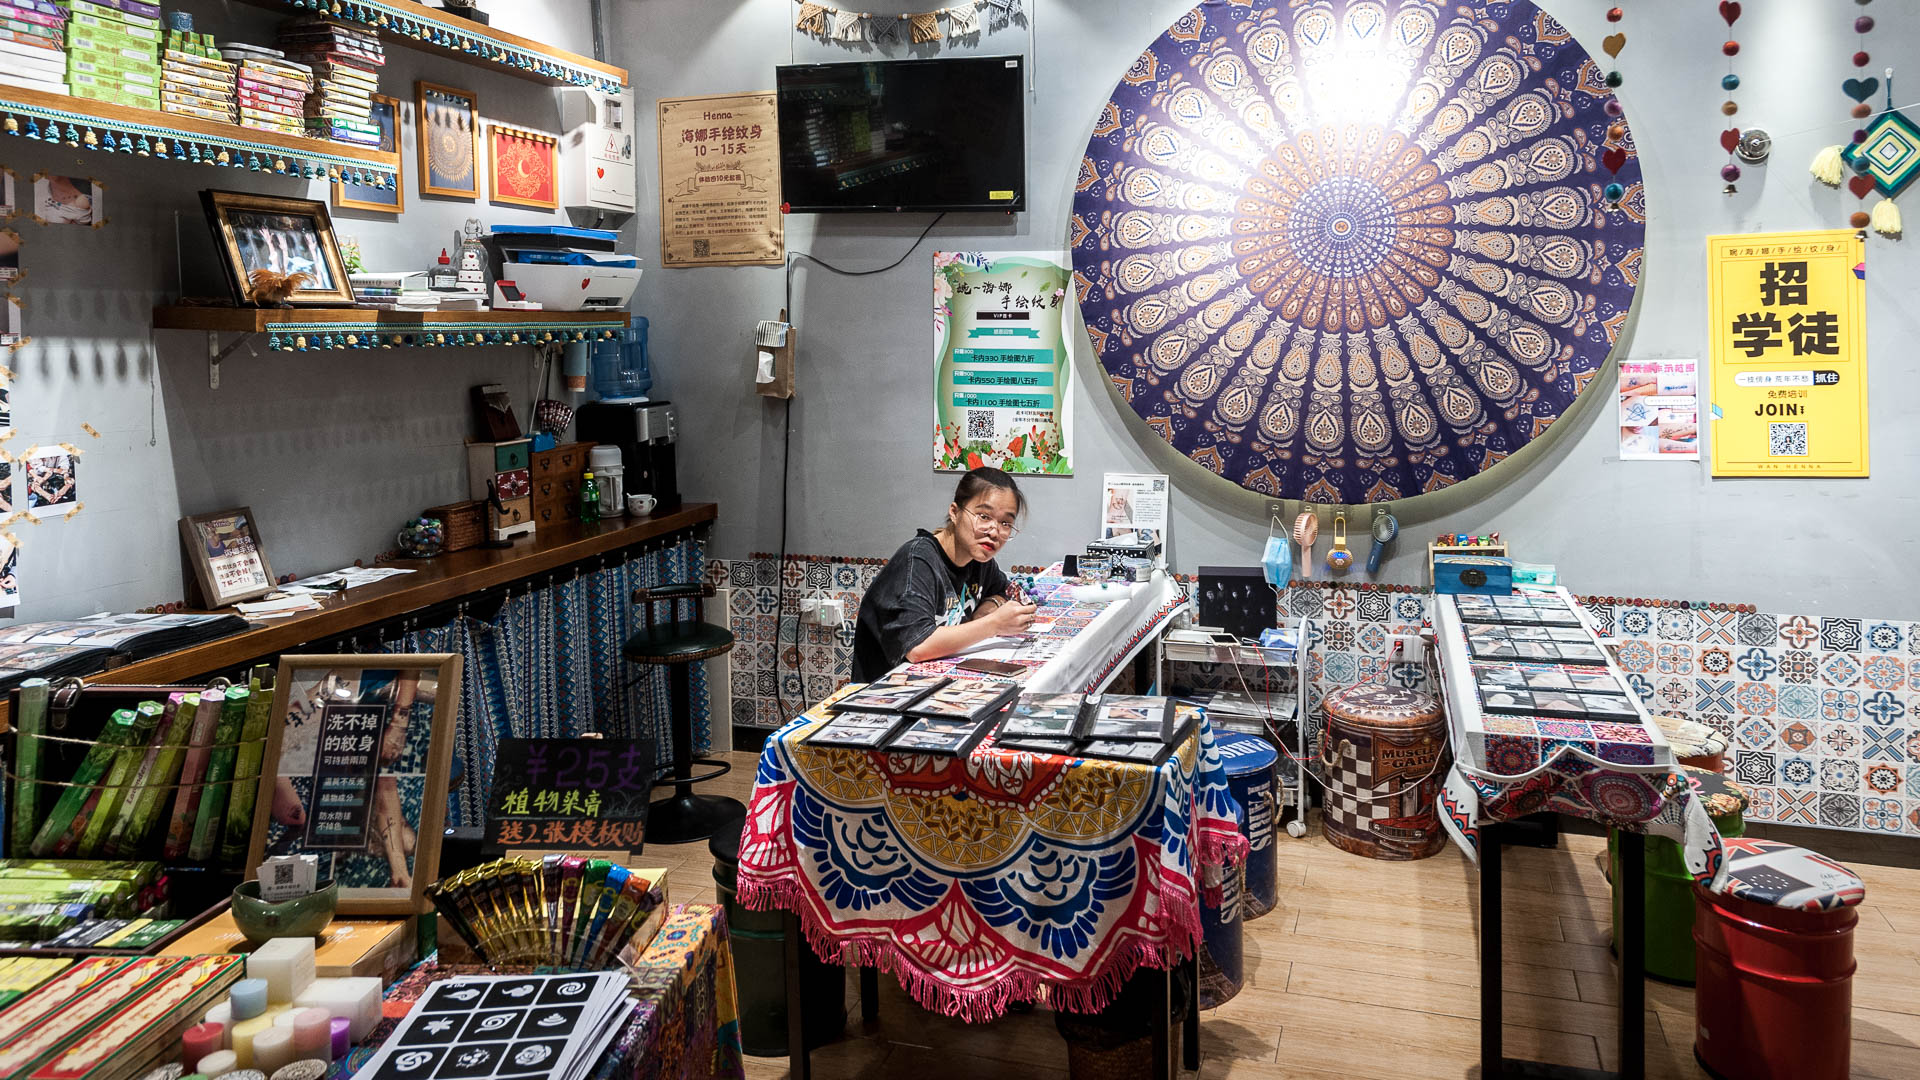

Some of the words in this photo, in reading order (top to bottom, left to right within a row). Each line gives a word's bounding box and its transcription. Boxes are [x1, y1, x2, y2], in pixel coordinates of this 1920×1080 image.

[703, 111, 733, 121] Henna
[681, 124, 763, 144] 海娜手绘纹身
[1760, 261, 1809, 306] 招
[1732, 310, 1840, 358] 学徒
[326, 713, 378, 732] 洗不掉
[324, 734, 375, 752] 的紋身
[1381, 744, 1436, 760] MUSCLE
[500, 786, 603, 818] 植物染膏
